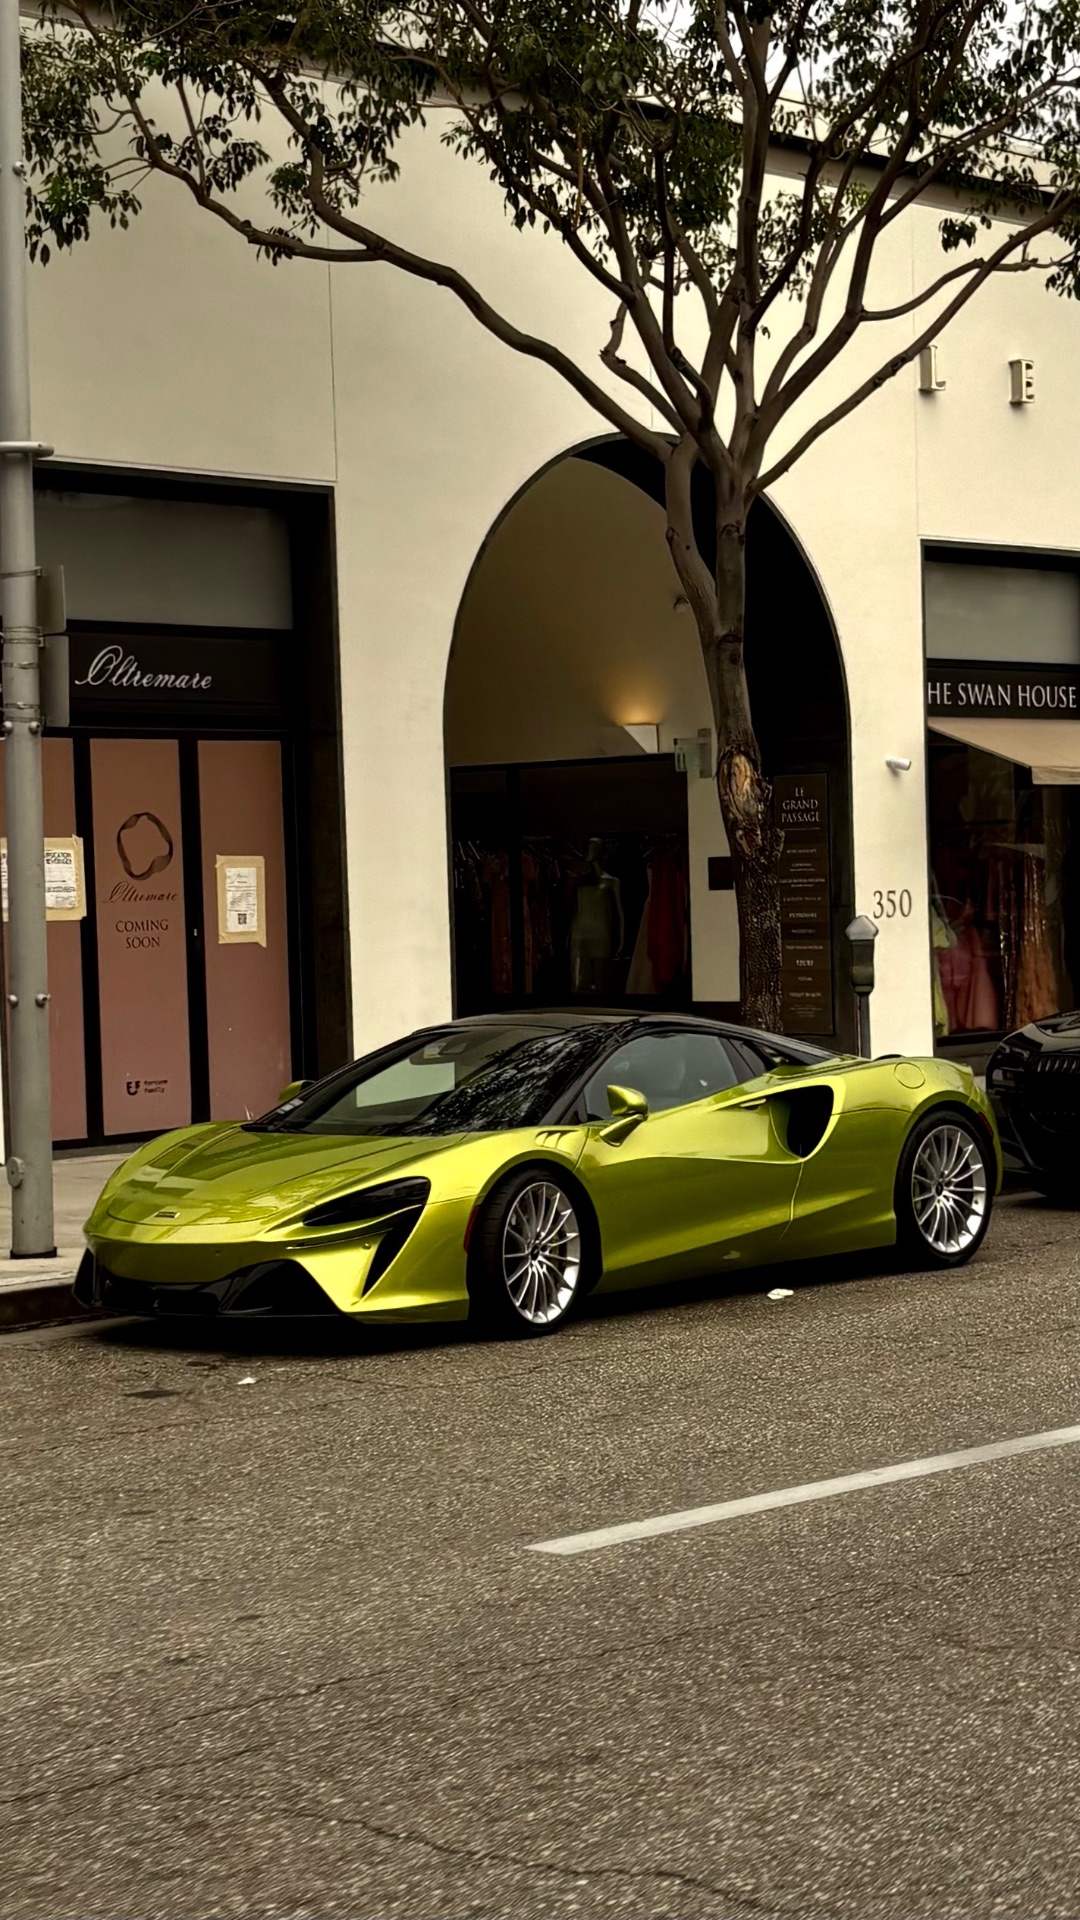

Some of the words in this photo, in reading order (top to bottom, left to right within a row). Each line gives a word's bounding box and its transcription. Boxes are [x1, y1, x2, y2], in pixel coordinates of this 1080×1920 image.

[75, 645, 212, 689] Oltremare
[927, 682, 952, 705] HE
[958, 683, 1011, 706] SWAN
[1018, 685, 1077, 708] HOUSE
[795, 787, 805, 797] LE
[782, 799, 819, 810] GRAND
[781, 811, 820, 823] PASSAGE
[873, 888, 912, 919] 350
[115, 919, 169, 933] COMING
[125, 936, 161, 949] SOON
